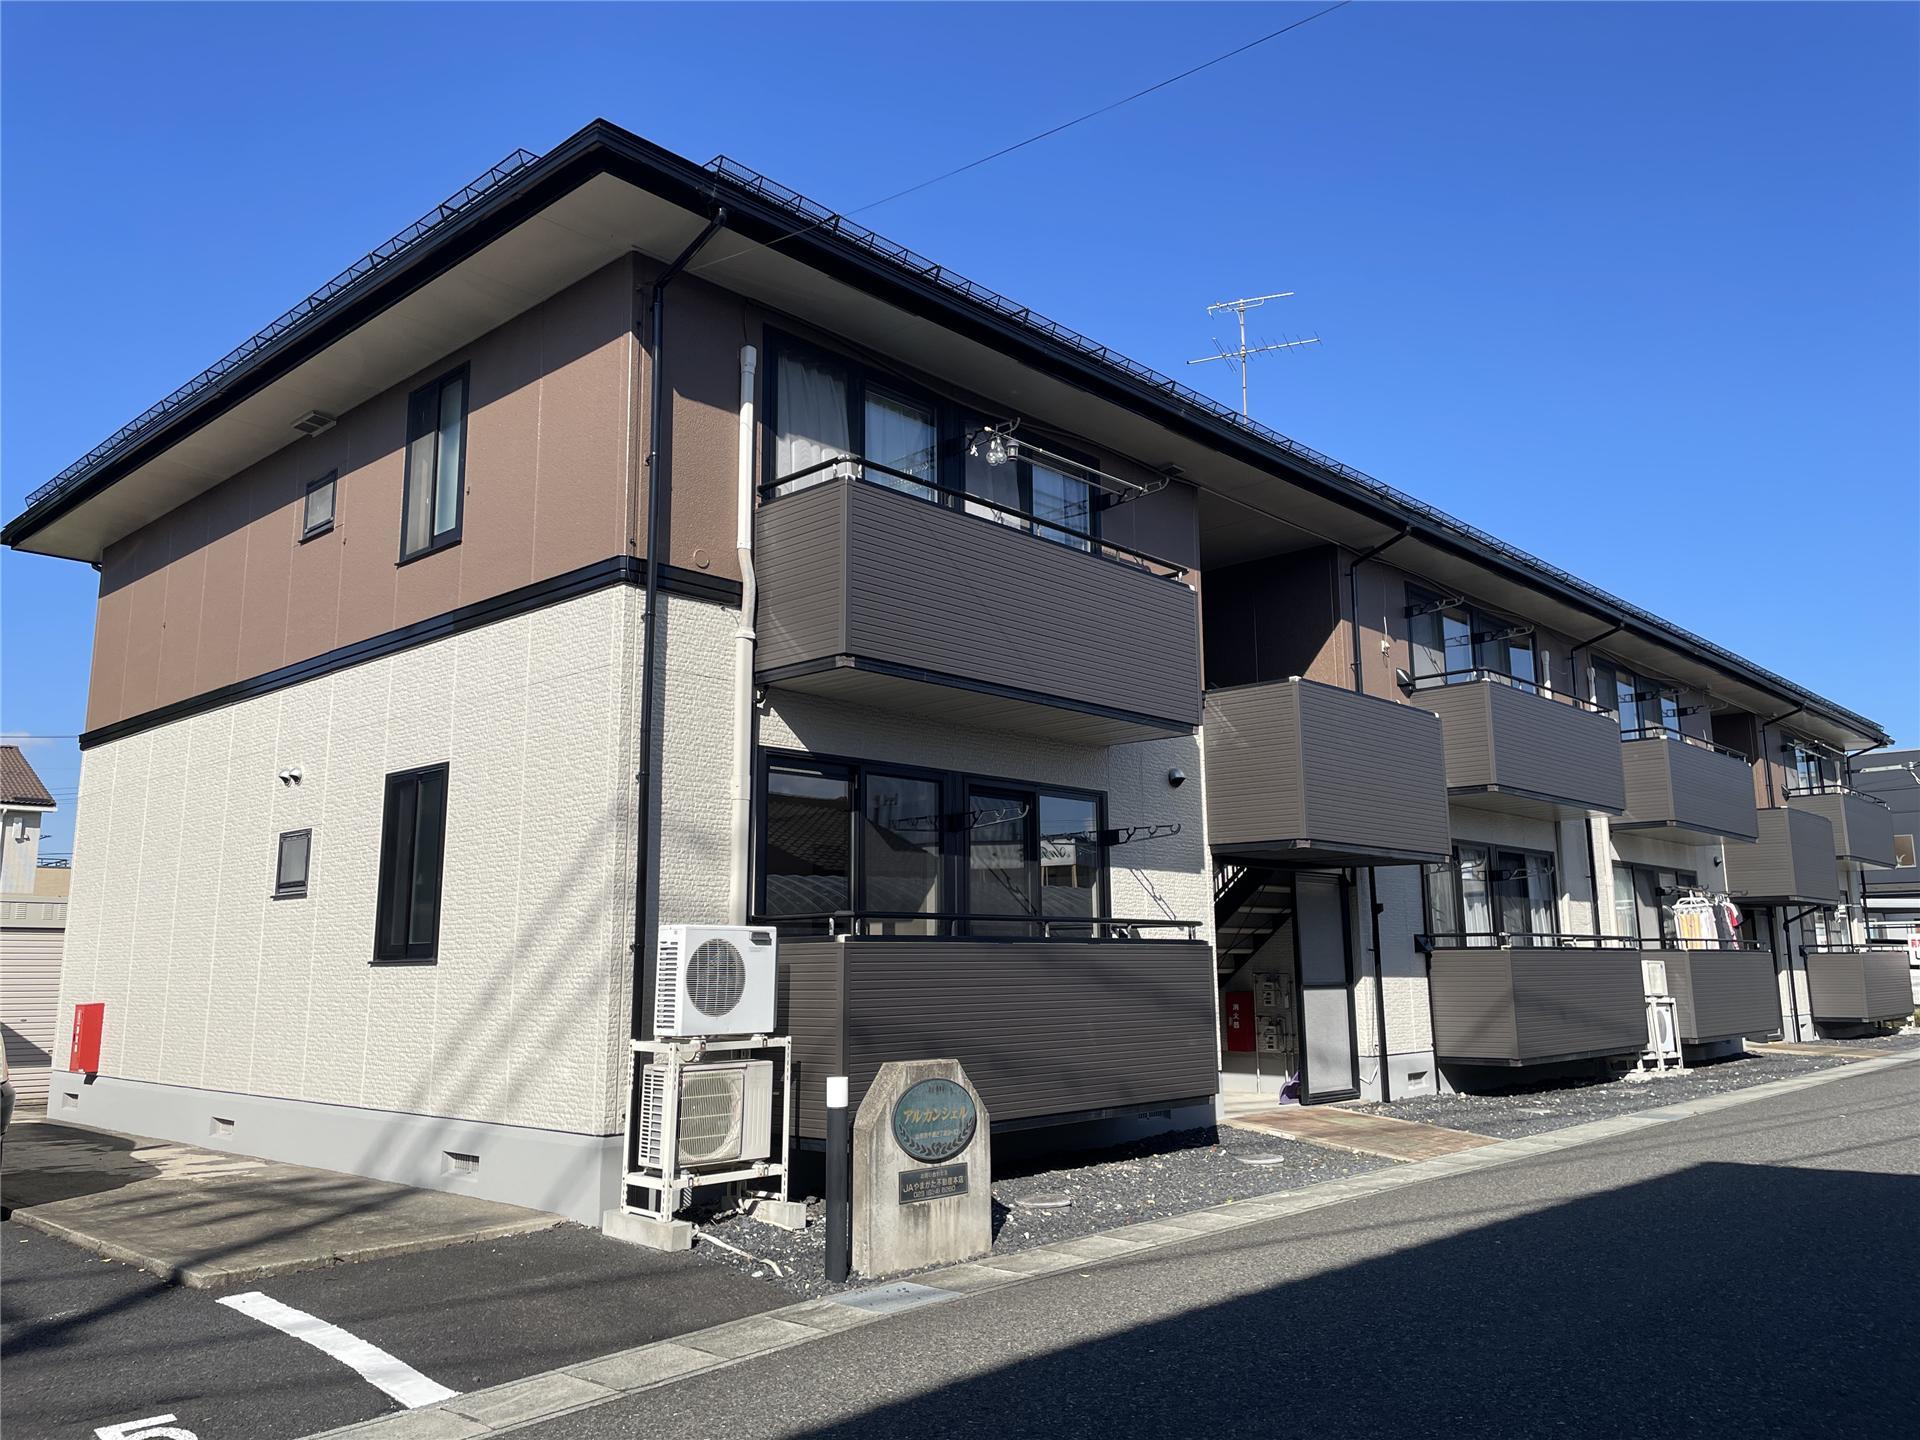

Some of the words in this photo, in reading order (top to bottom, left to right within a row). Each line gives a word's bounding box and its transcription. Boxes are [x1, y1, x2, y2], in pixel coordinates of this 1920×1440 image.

[903, 1105, 968, 1125] アルカンシェル
